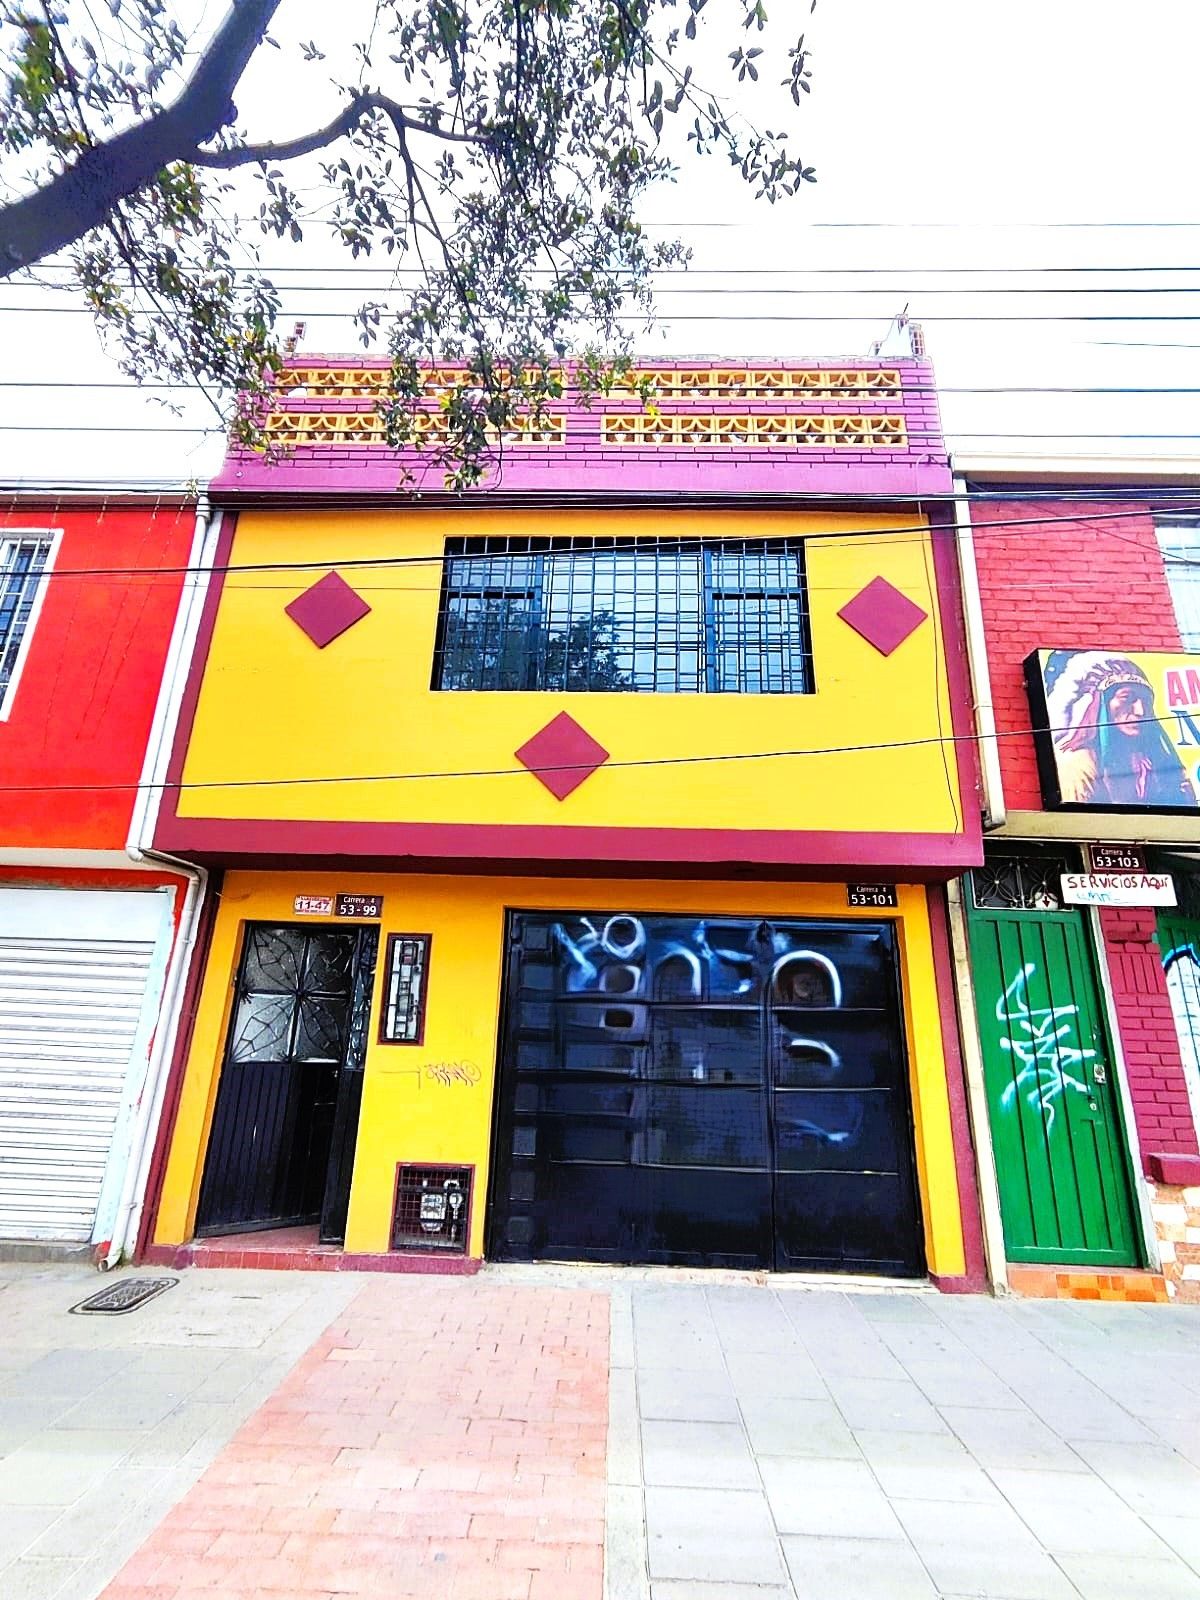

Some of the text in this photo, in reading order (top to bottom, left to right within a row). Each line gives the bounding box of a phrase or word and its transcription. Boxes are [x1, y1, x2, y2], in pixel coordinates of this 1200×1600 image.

[1096, 856, 1140, 868] 53-103
[1067, 875, 1138, 889] SERVICIOS
[343, 896, 366, 904] Carrera
[851, 894, 893, 905] 53-101
